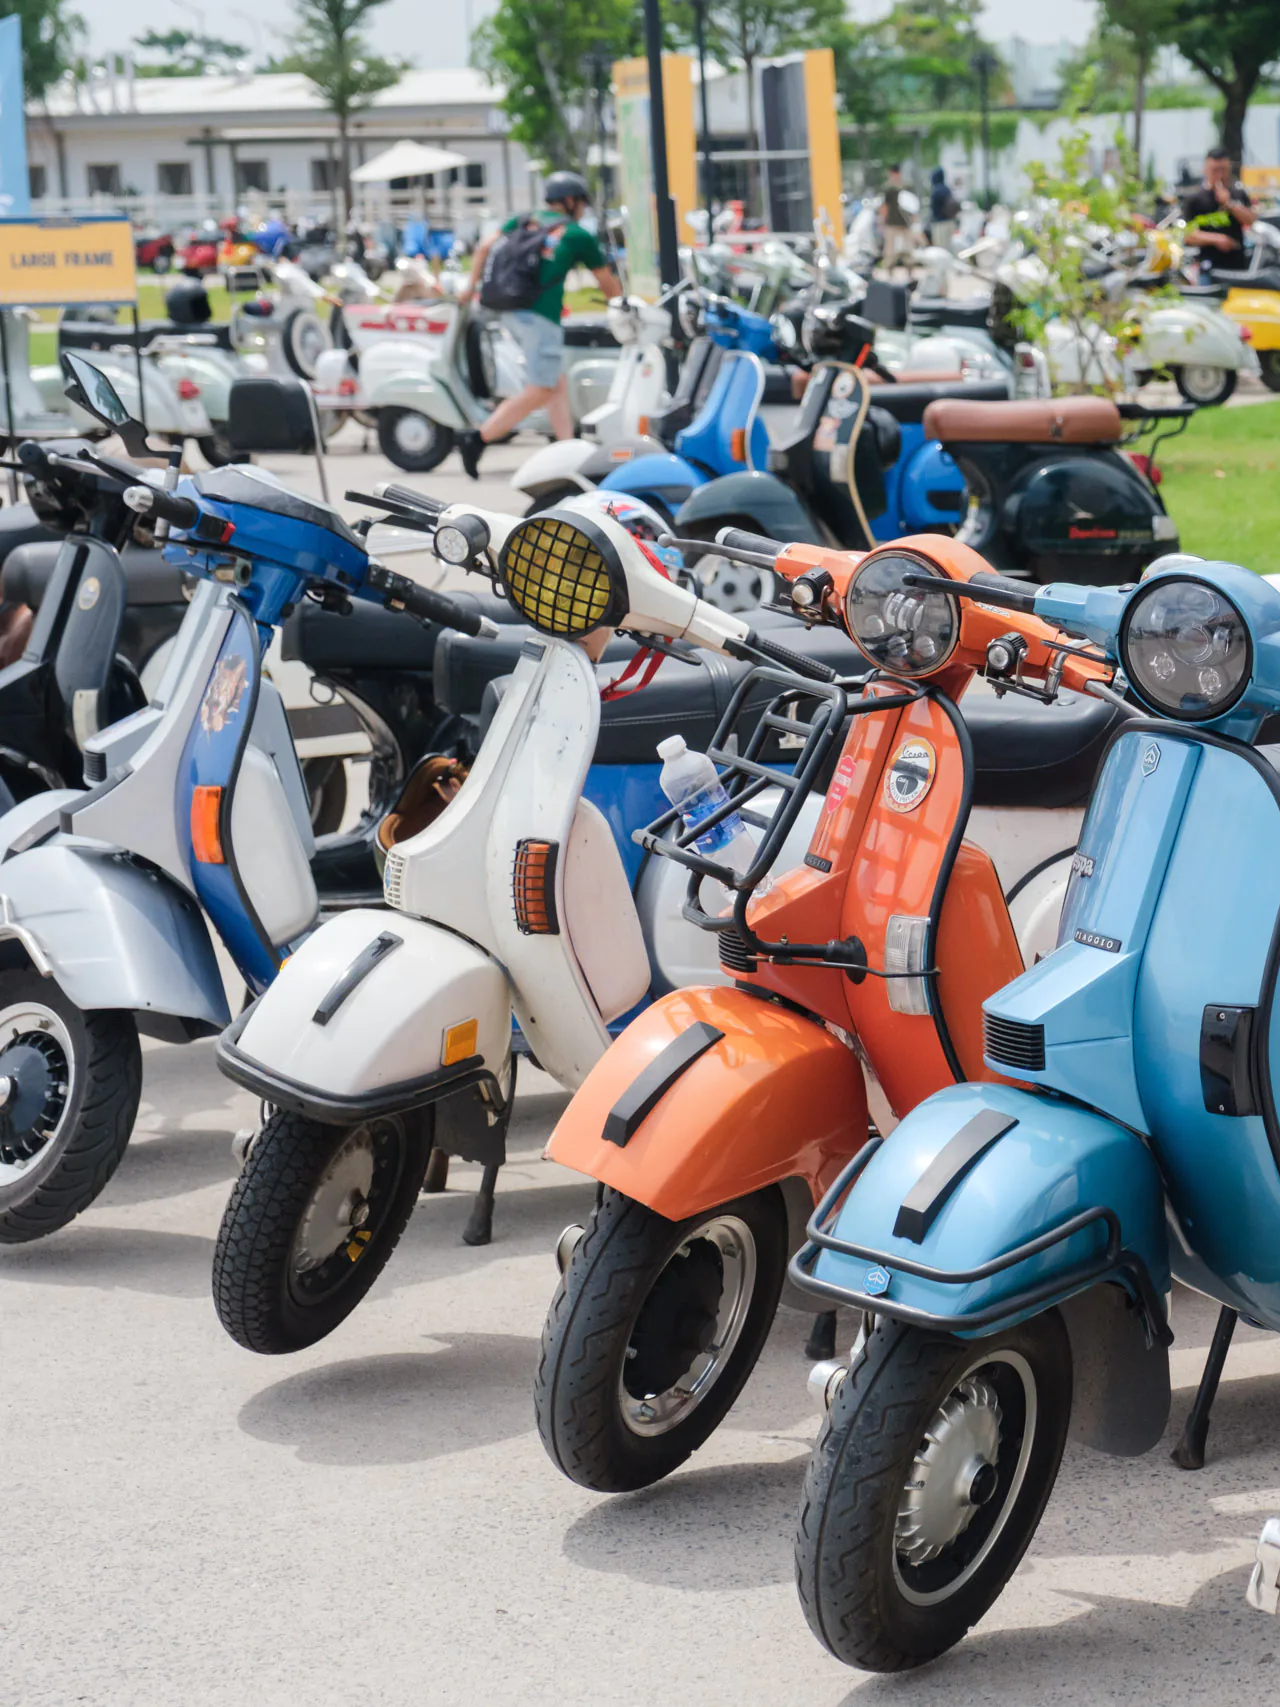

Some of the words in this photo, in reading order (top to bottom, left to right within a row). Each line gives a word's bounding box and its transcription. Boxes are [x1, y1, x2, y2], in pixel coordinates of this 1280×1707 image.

[9, 252, 56, 269] LARGE
[64, 250, 113, 267] FRAME
[1075, 931, 1114, 949] PIAGGIO
